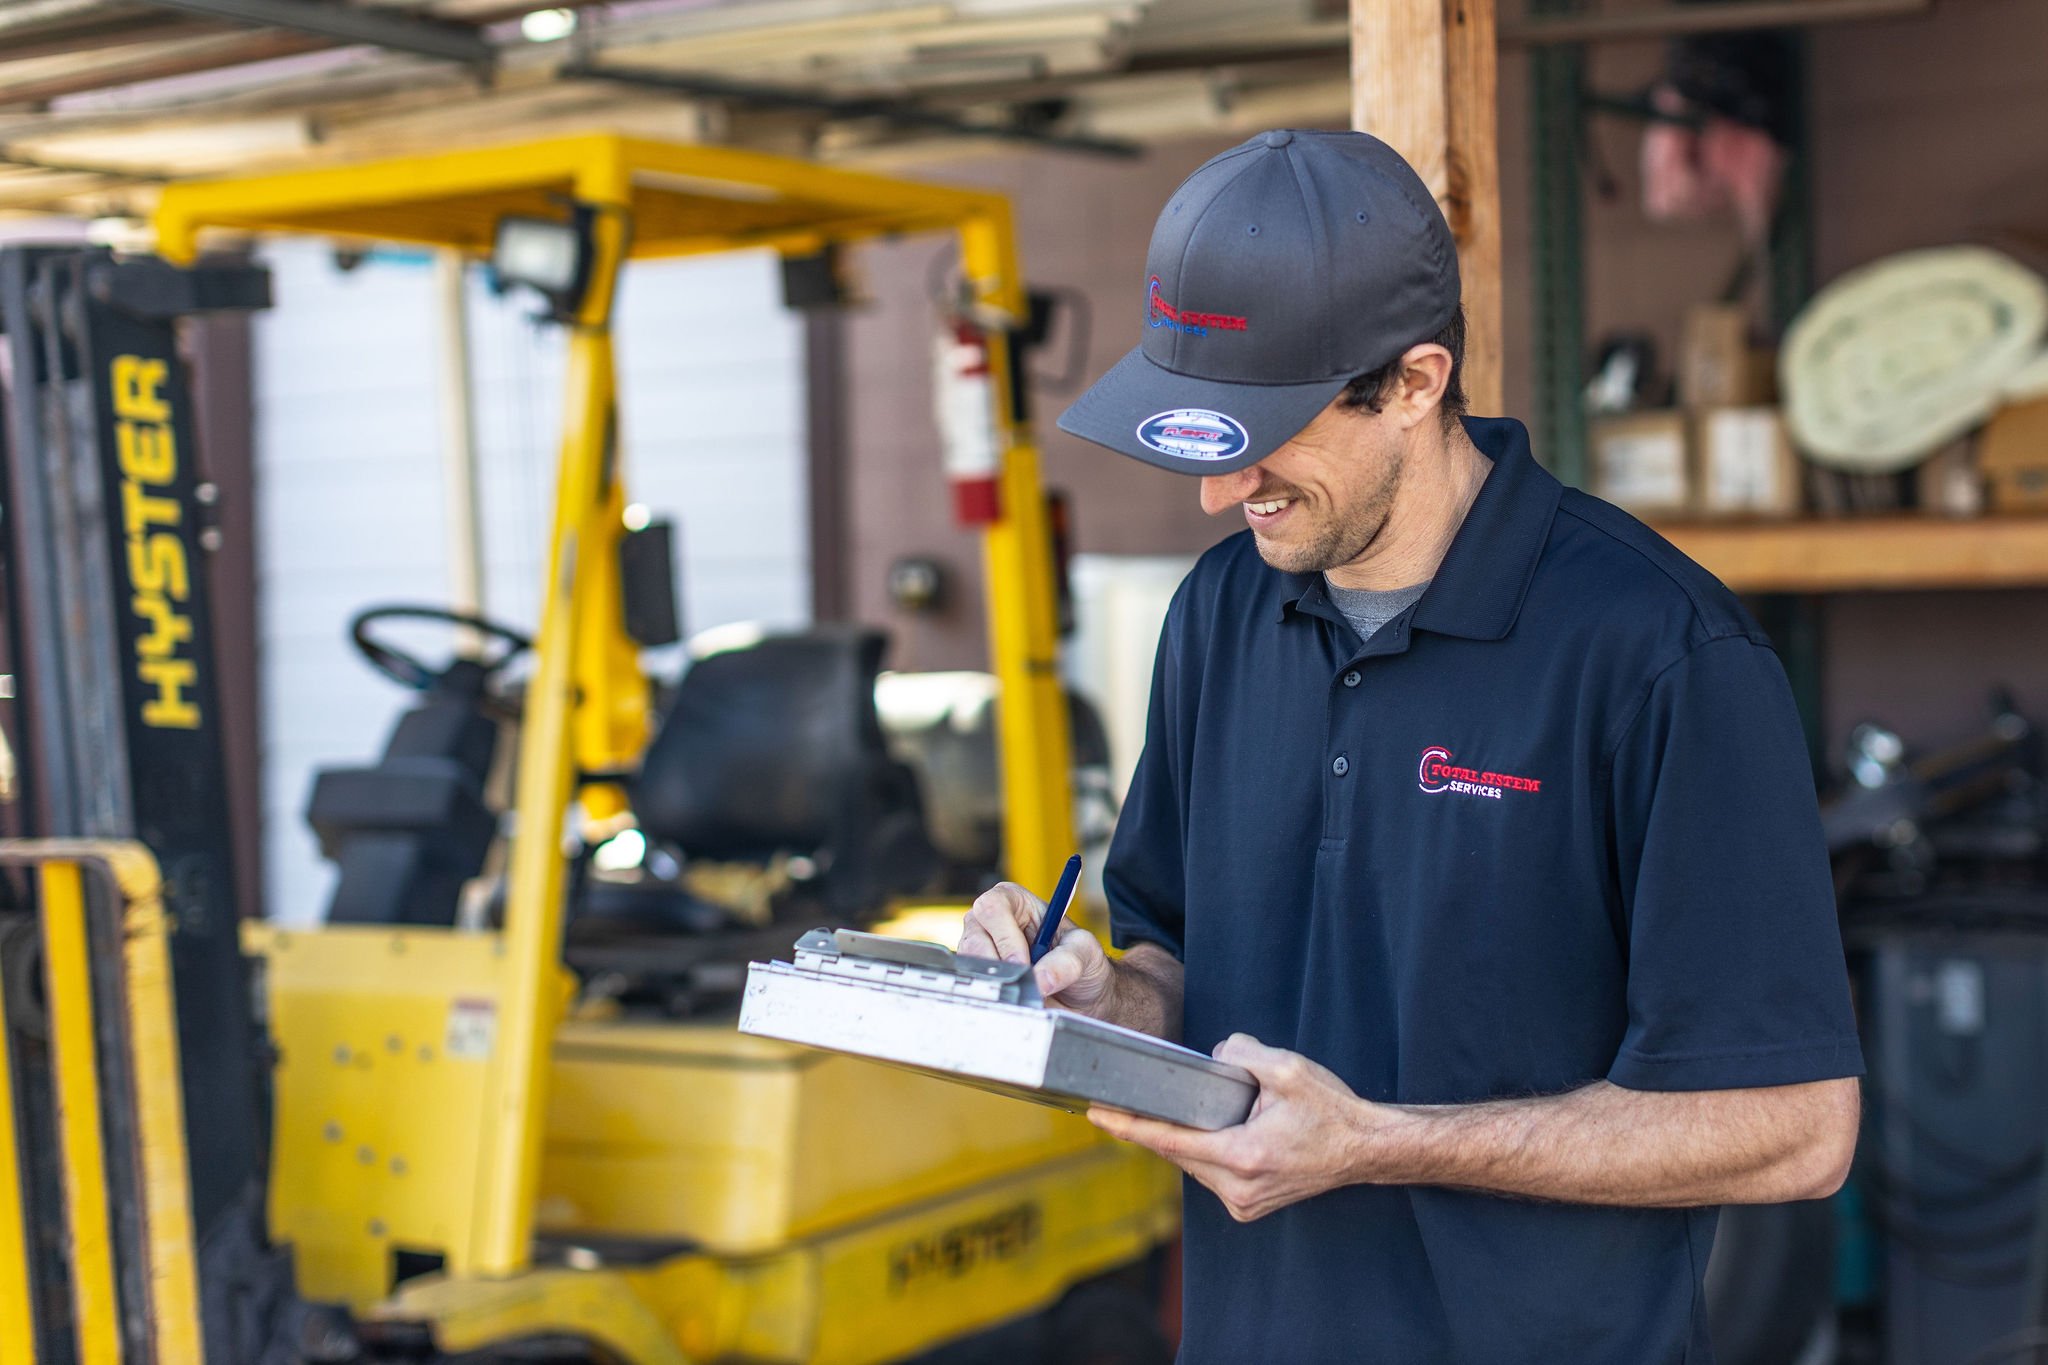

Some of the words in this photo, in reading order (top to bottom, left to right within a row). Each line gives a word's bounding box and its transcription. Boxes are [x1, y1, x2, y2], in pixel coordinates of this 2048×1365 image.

[110, 354, 200, 729] HYSTER
[1431, 763, 1479, 784] TOTAL
[1480, 771, 1541, 793] SYSTEM
[1449, 780, 1502, 799] SERVICES
